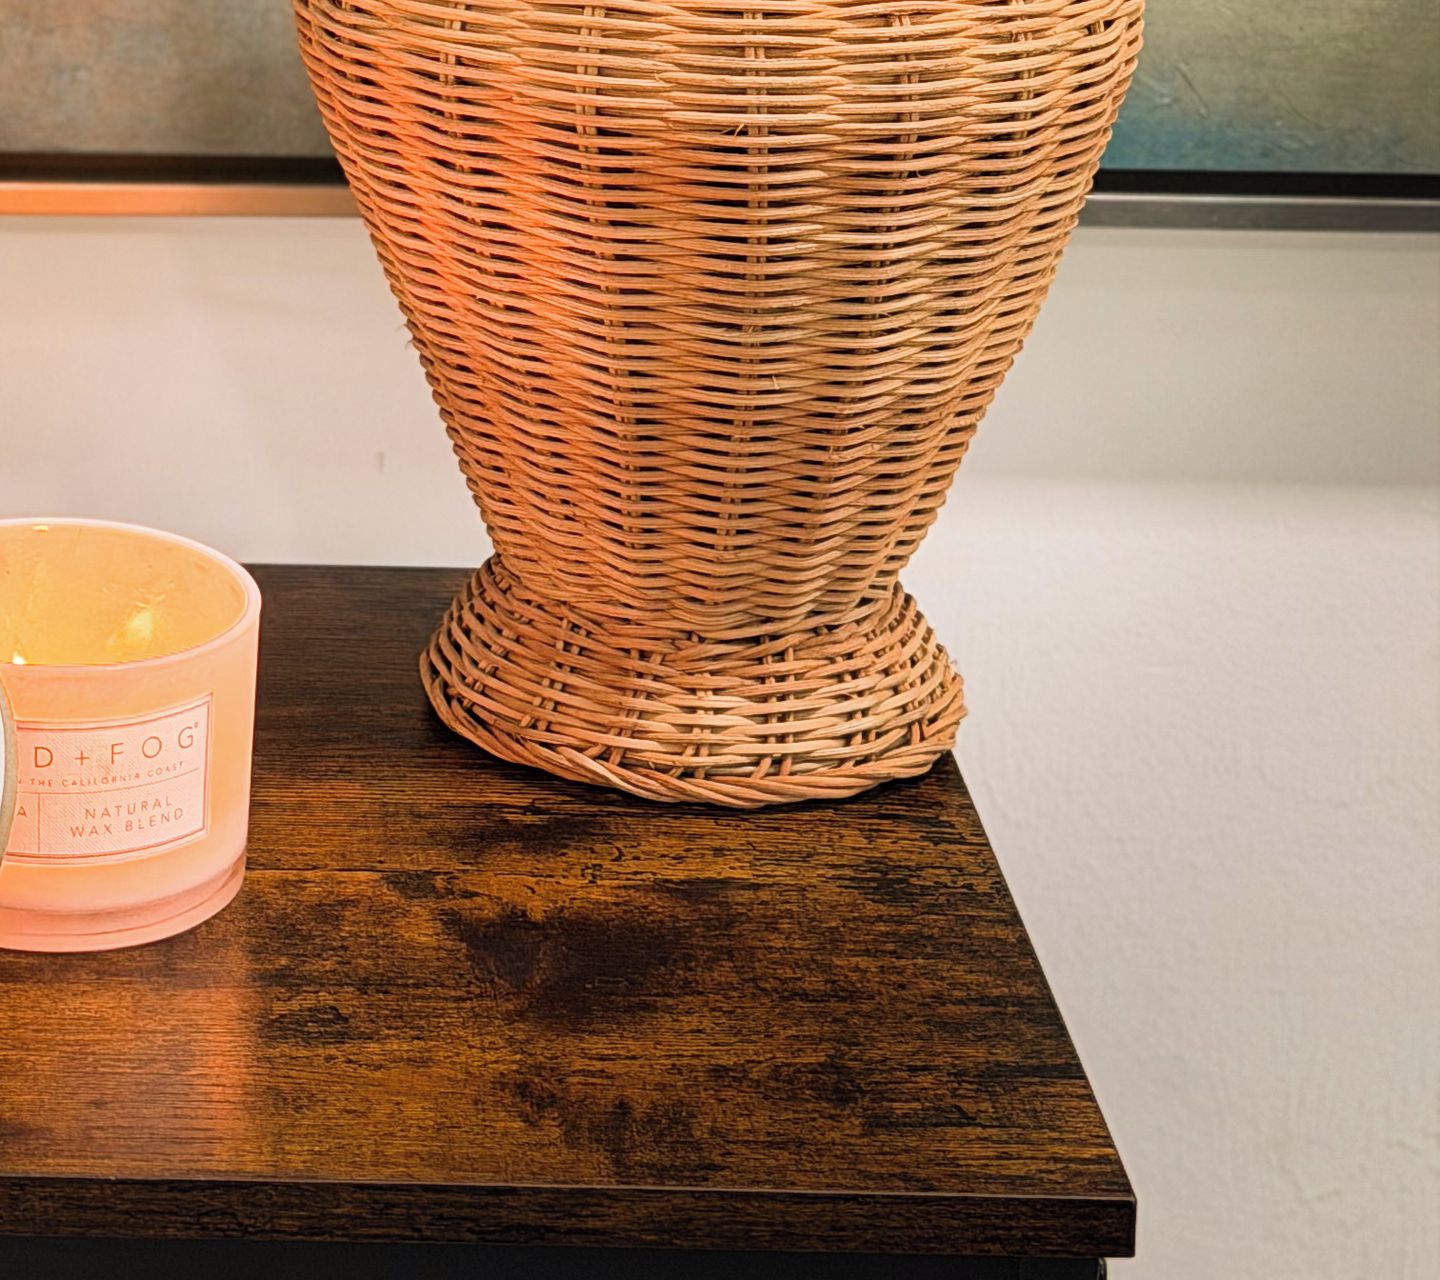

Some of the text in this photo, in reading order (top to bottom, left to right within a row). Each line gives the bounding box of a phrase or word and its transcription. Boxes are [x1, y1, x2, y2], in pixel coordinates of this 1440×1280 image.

[30, 778, 53, 788] THE
[84, 795, 173, 820] NATURAL
[70, 807, 183, 838] WAX BLEND
